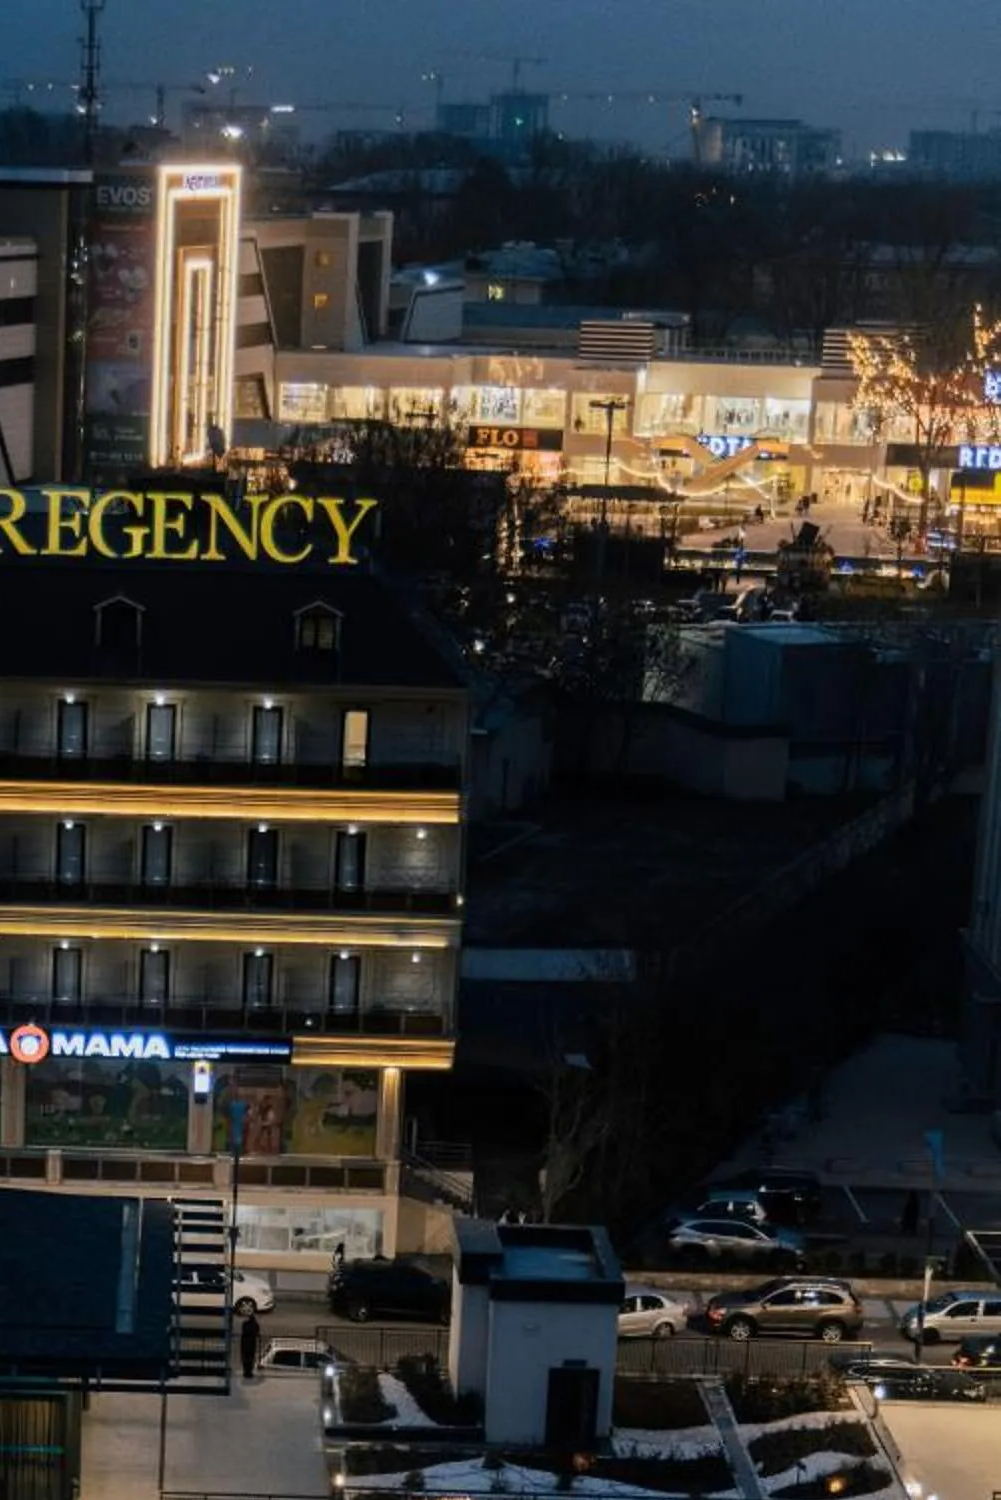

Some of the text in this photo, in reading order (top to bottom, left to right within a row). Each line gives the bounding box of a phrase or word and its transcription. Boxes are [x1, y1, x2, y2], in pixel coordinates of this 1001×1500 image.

[96, 186, 151, 206] EVOS
[475, 427, 520, 447] FLO
[52, 1031, 171, 1060] MAMA
